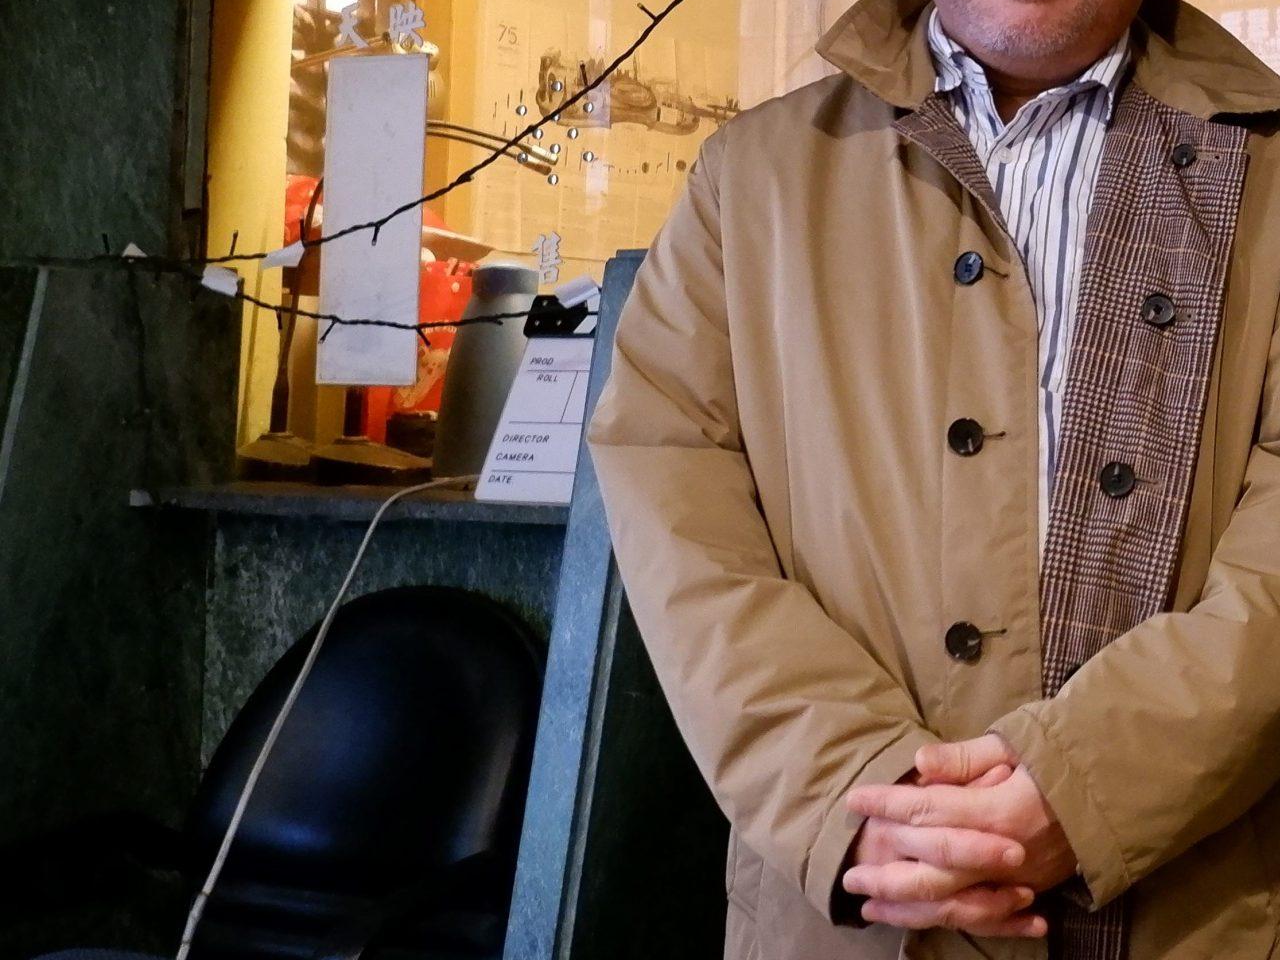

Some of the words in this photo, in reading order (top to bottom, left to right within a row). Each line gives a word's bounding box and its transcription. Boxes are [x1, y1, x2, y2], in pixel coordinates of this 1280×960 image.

[530, 357, 554, 366] PROD
[536, 373, 559, 383] ROLL
[502, 433, 550, 444] DIRECTOR
[495, 452, 535, 462] CAMERA
[488, 474, 513, 484] DATE
